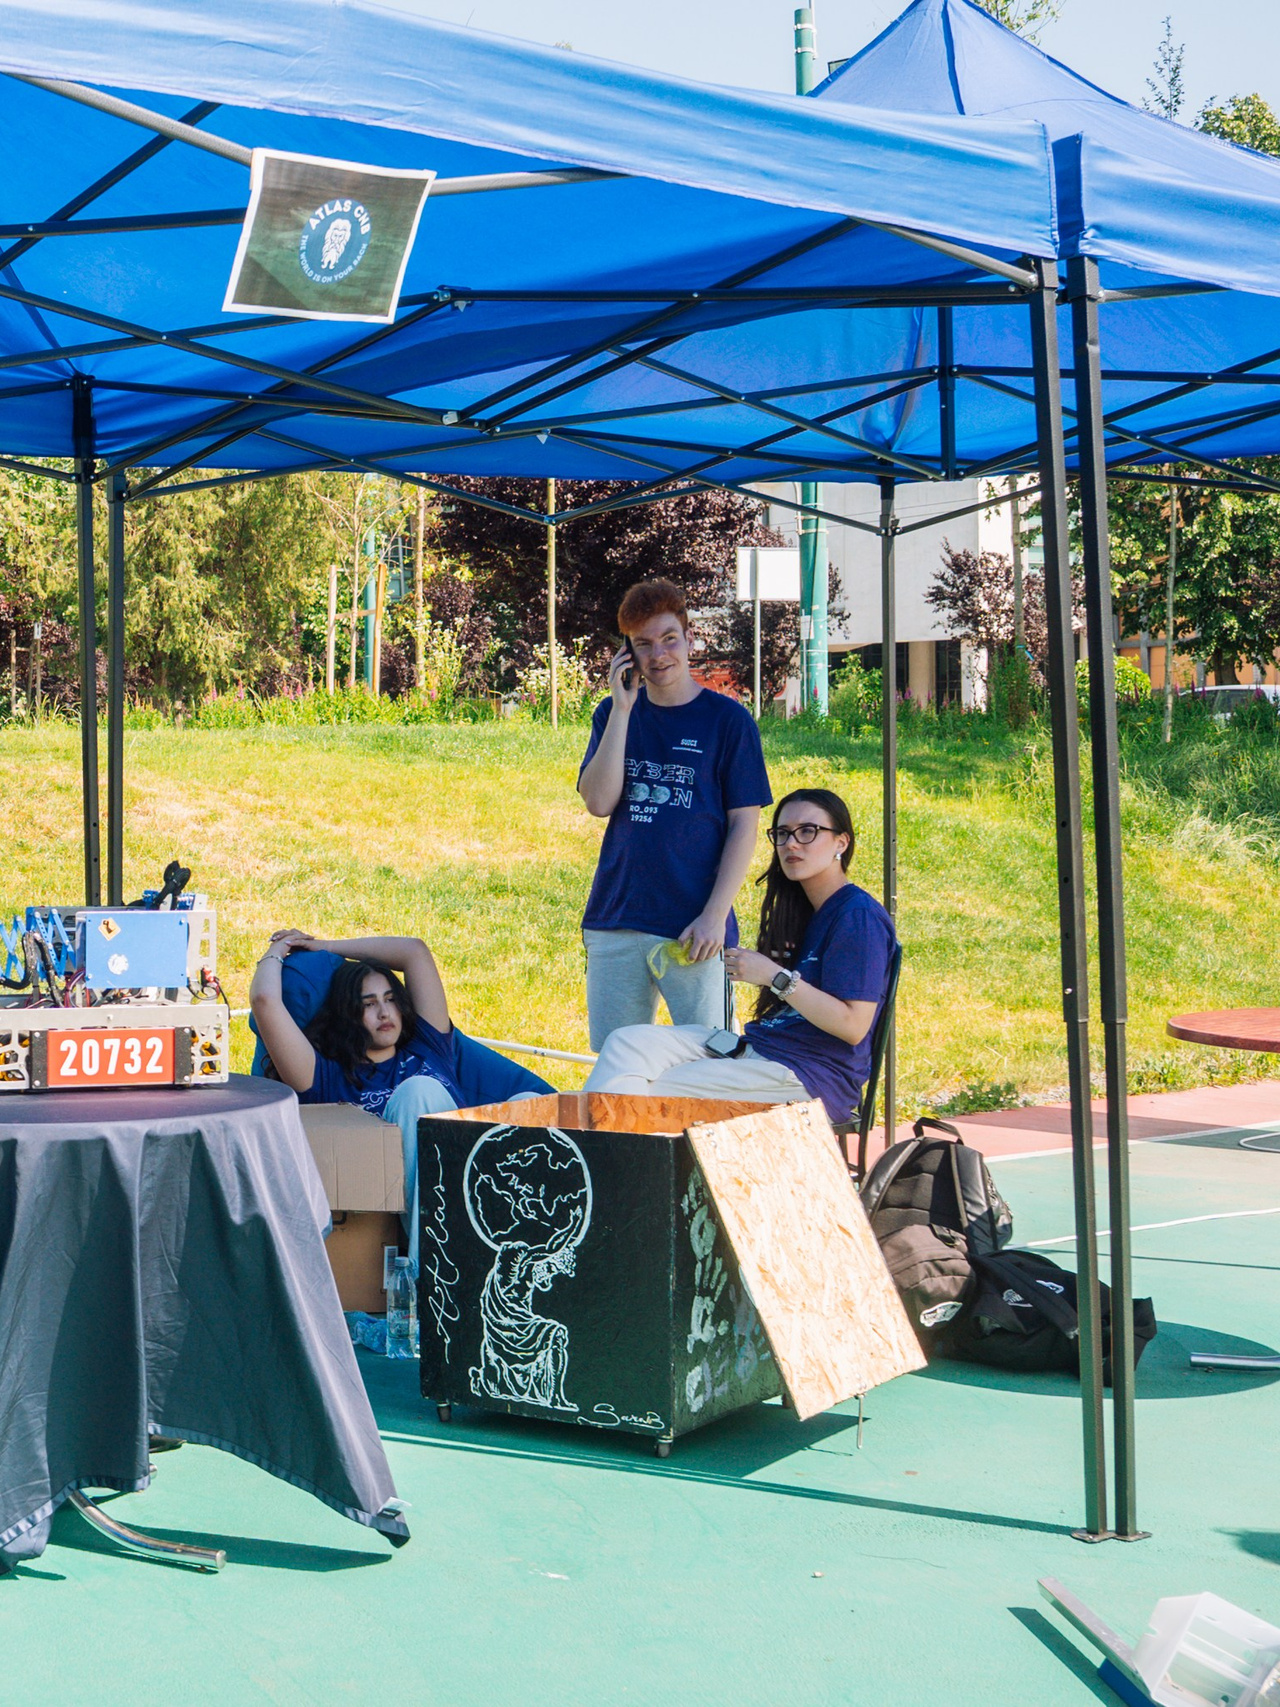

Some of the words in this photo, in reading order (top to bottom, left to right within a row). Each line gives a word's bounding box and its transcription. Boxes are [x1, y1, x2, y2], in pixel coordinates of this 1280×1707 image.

[309, 200, 352, 230] ATLAS
[353, 205, 371, 235] CNB
[300, 235, 308, 250] THE
[300, 251, 314, 277] WORLD
[353, 243, 367, 266] BACK
[312, 273, 321, 282] IS
[321, 275, 333, 284] ON
[334, 265, 353, 280] YOUR
[625, 758, 695, 785] YBER
[631, 814, 653, 823] 19256
[59, 1036, 164, 1077] 20732
[425, 1143, 460, 1364] Atlas
